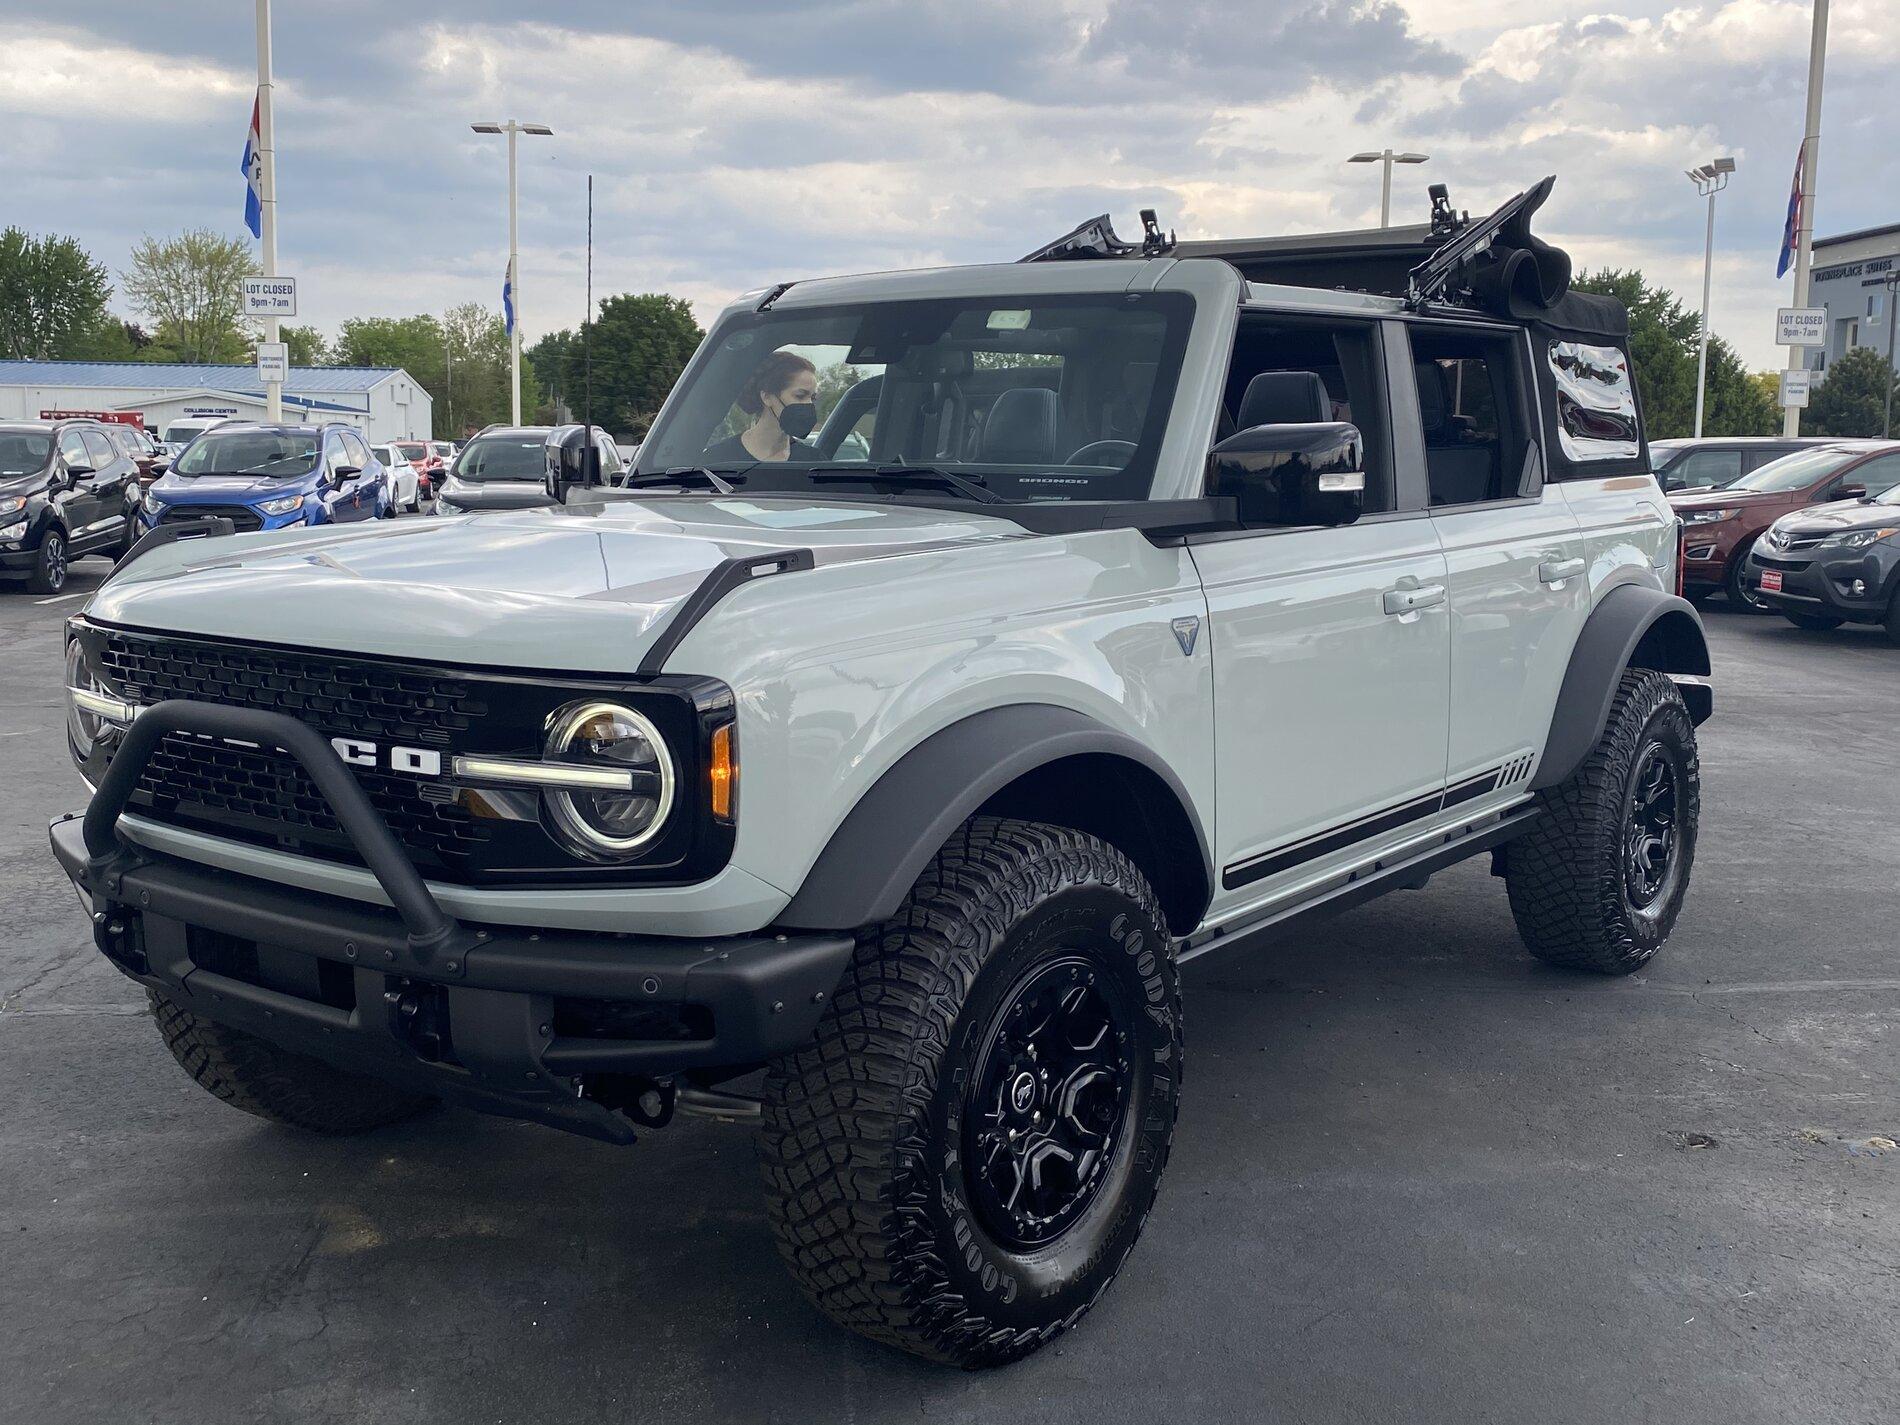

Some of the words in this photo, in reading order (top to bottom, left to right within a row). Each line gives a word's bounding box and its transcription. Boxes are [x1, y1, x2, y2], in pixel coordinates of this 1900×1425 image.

[246, 284, 260, 294] LOT
[263, 284, 293, 295] CLOSED
[1780, 315, 1794, 325] LOT
[1796, 315, 1823, 325] CLOSED
